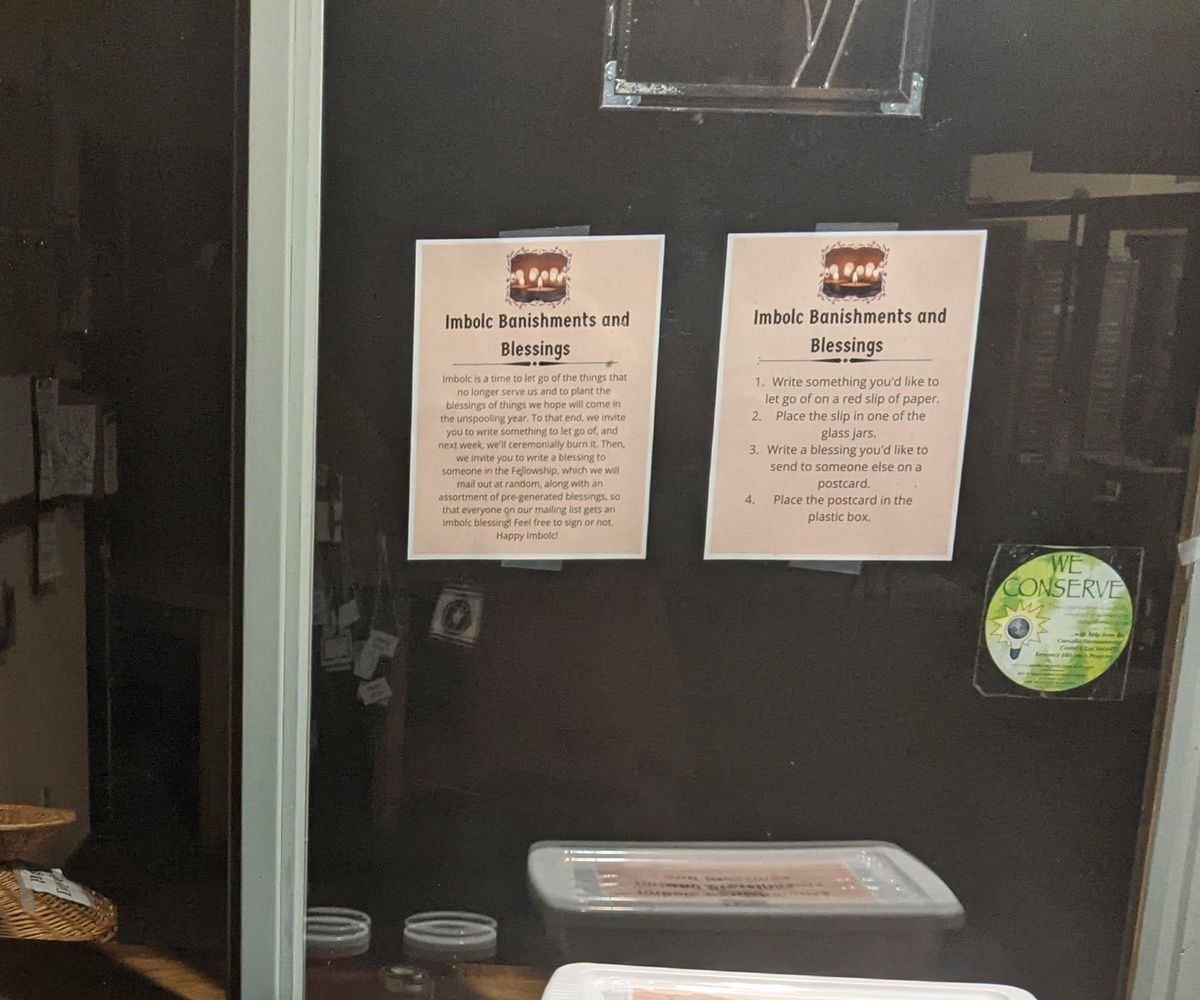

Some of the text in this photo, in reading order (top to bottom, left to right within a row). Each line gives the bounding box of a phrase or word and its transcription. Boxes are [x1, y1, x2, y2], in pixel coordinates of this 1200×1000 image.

[445, 310, 630, 330] Imbolc Banishments and
[753, 306, 947, 325] Imbolc Banishments and
[500, 339, 570, 360] Blessings
[810, 336, 883, 358] Blessings
[442, 372, 627, 384] Imbolc is a time to let go of the things that
[755, 375, 939, 390] 1. Write something you'd like to
[471, 387, 499, 398] longer
[501, 388, 525, 396] serve
[527, 388, 538, 396] us
[539, 386, 557, 396] and
[559, 387, 568, 395] to
[570, 386, 594, 397] plant
[595, 386, 611, 395] the
[445, 400, 486, 412] blessings
[487, 400, 498, 409] of
[499, 400, 526, 411] things
[528, 401, 541, 409] we
[543, 400, 567, 410] hope
[568, 399, 583, 408] will
[612, 399, 621, 408] in
[765, 392, 939, 407] let go of on a red slip of paper.
[440, 412, 626, 425] the unspooling year. To that end, we invite
[751, 409, 926, 422] 2. Place the slip in one of the
[820, 427, 876, 441] glass jars.
[748, 443, 928, 458] 3. Write a blessing you'd like to
[769, 460, 922, 472] send to someone else on a
[817, 477, 870, 491] postcard.
[744, 493, 912, 507] 4. Place the postcard in the
[807, 510, 871, 524] plastic box.
[495, 530, 558, 542] Happy Imbolc!
[1050, 554, 1083, 574] WE
[1003, 577, 1124, 599] CONSERVE
